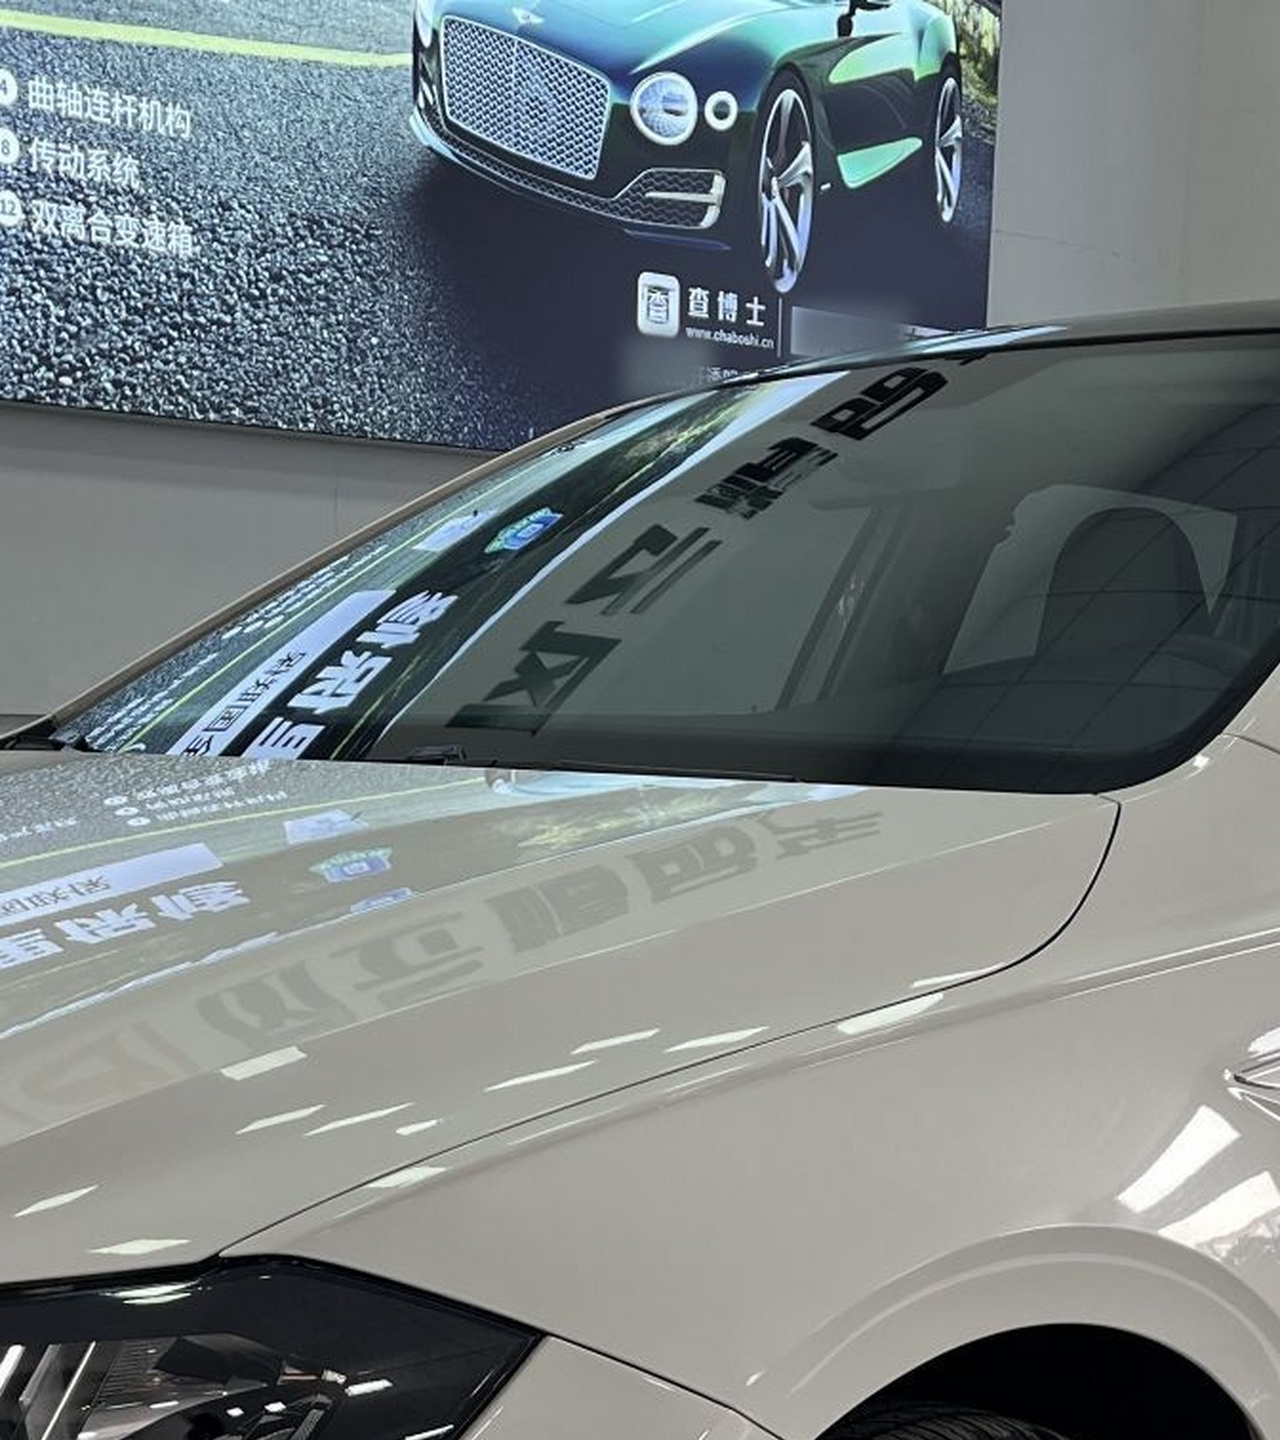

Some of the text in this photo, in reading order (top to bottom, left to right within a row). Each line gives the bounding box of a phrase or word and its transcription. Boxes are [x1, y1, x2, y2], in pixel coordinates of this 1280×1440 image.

[27, 80, 192, 138] 曲轴连杆机构
[27, 137, 141, 189] 传动系统
[32, 200, 195, 257] 双离合变速箱
[688, 287, 766, 327] 查博士
[685, 326, 775, 350] www.chaboshi.cn
